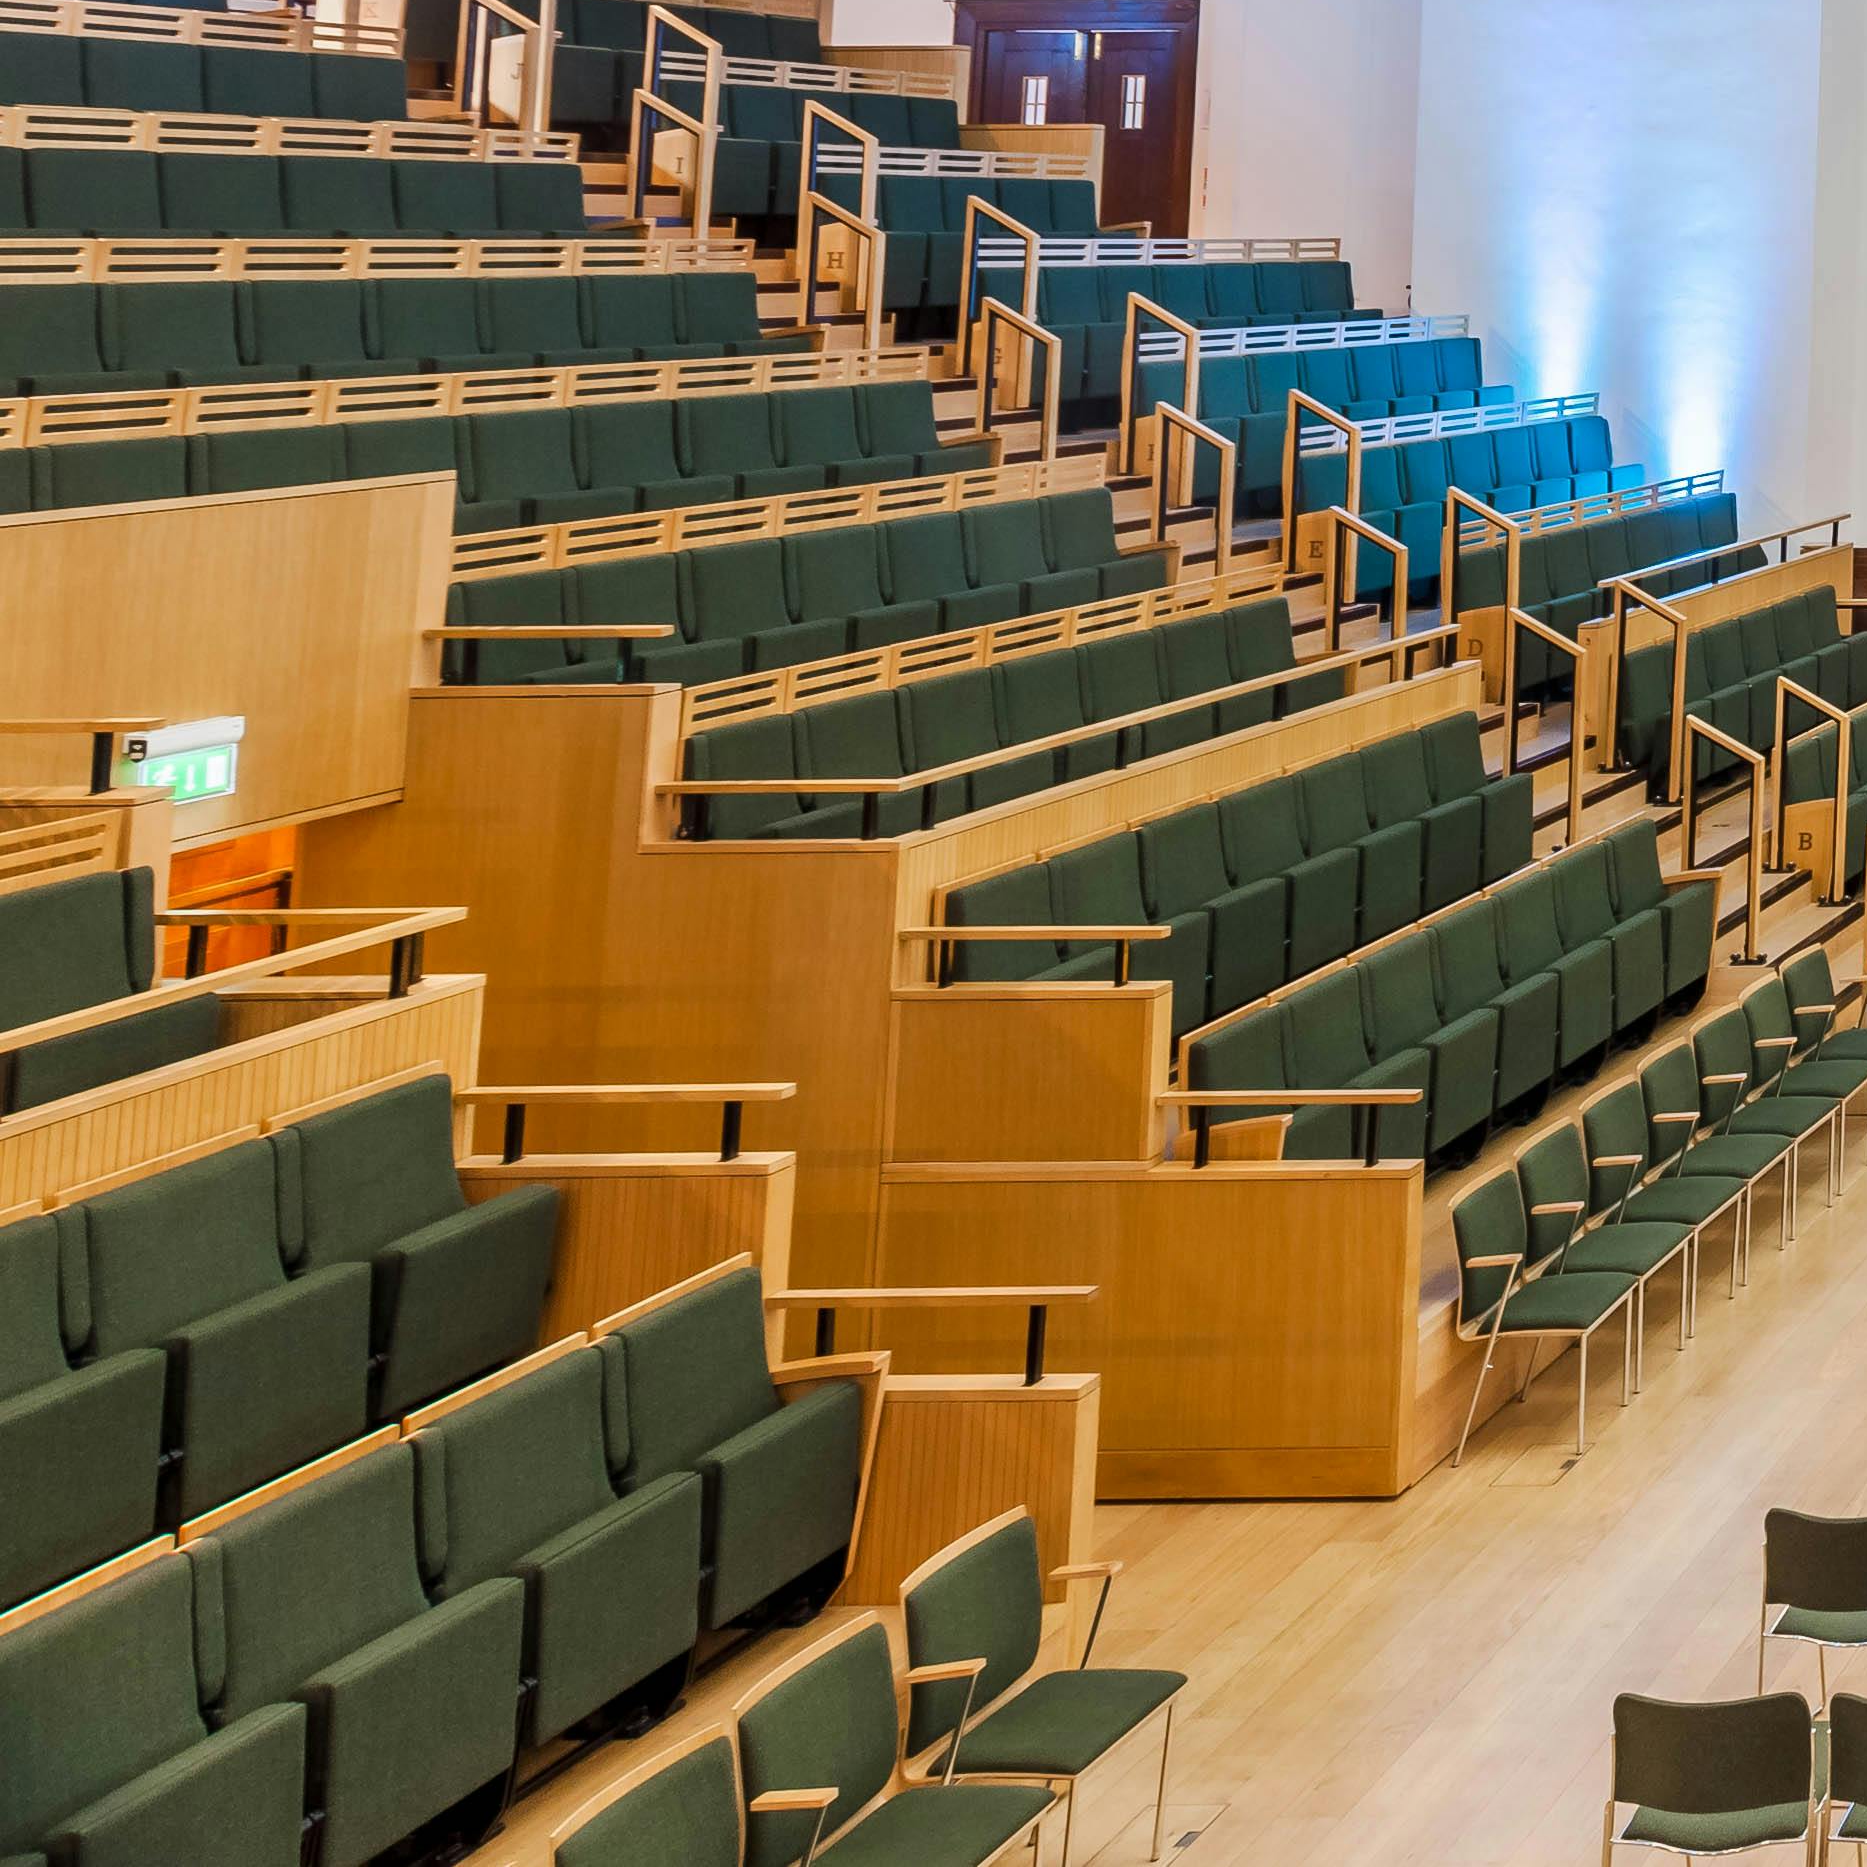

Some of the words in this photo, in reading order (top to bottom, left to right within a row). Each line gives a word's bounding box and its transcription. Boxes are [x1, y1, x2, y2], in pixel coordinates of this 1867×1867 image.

[675, 156, 684, 174] I
[826, 251, 845, 269] H
[1308, 540, 1323, 558] E
[1467, 638, 1484, 657] D
[1798, 832, 1813, 851] B
